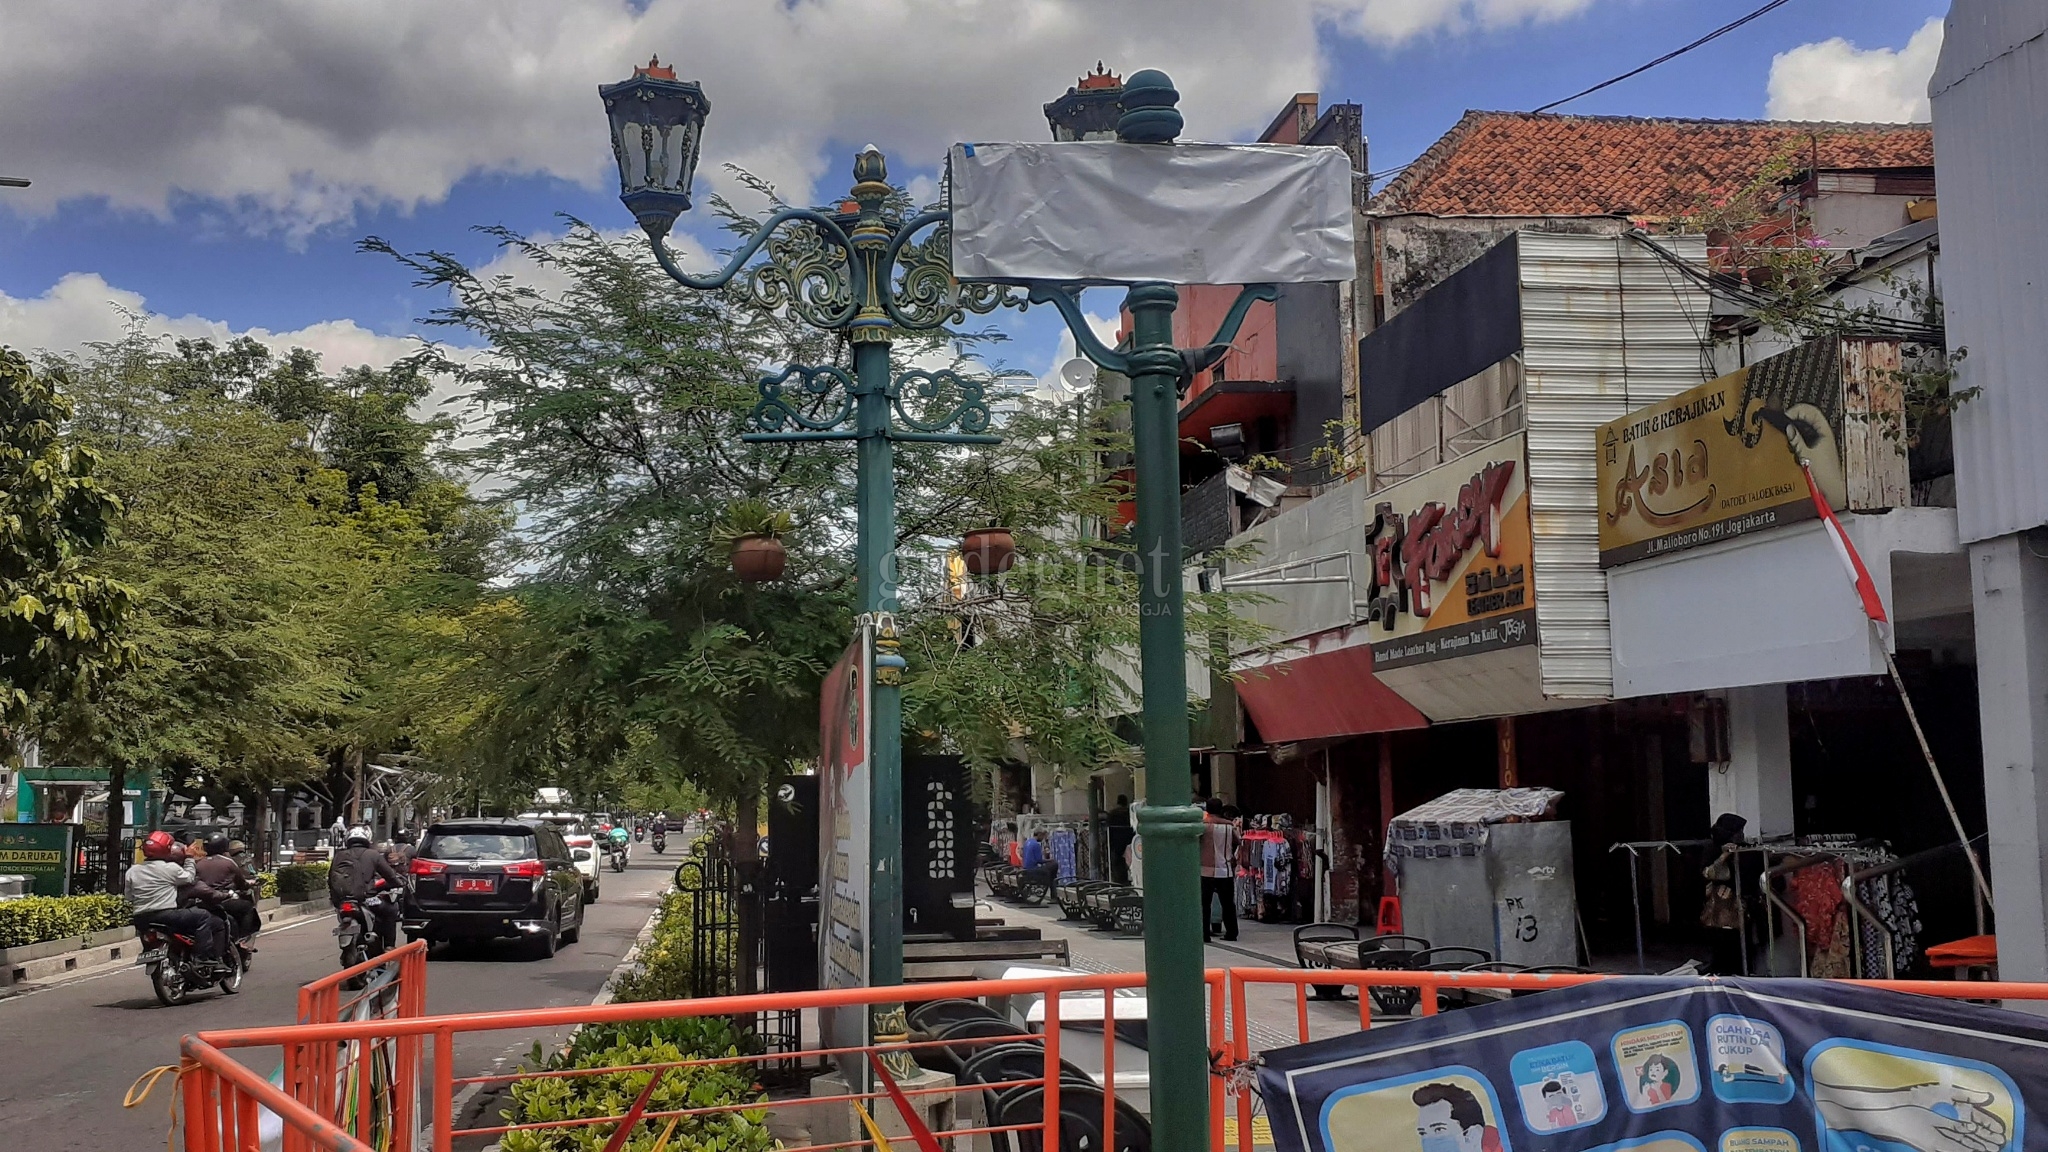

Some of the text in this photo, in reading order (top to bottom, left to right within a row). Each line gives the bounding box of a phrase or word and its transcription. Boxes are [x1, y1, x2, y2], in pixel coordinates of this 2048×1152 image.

[1622, 390, 1725, 443] BATIK & KERAJINAN
[1607, 439, 1711, 518] Asia
[1726, 511, 1776, 534] Jogjakarta
[11, 851, 60, 861] DARURAT
[1715, 1024, 1742, 1034] OLAH
[1716, 1034, 1748, 1045] RUTIN
[1718, 1045, 1753, 1056] CUKUP
[1751, 1138, 1790, 1147] SAMPAH
